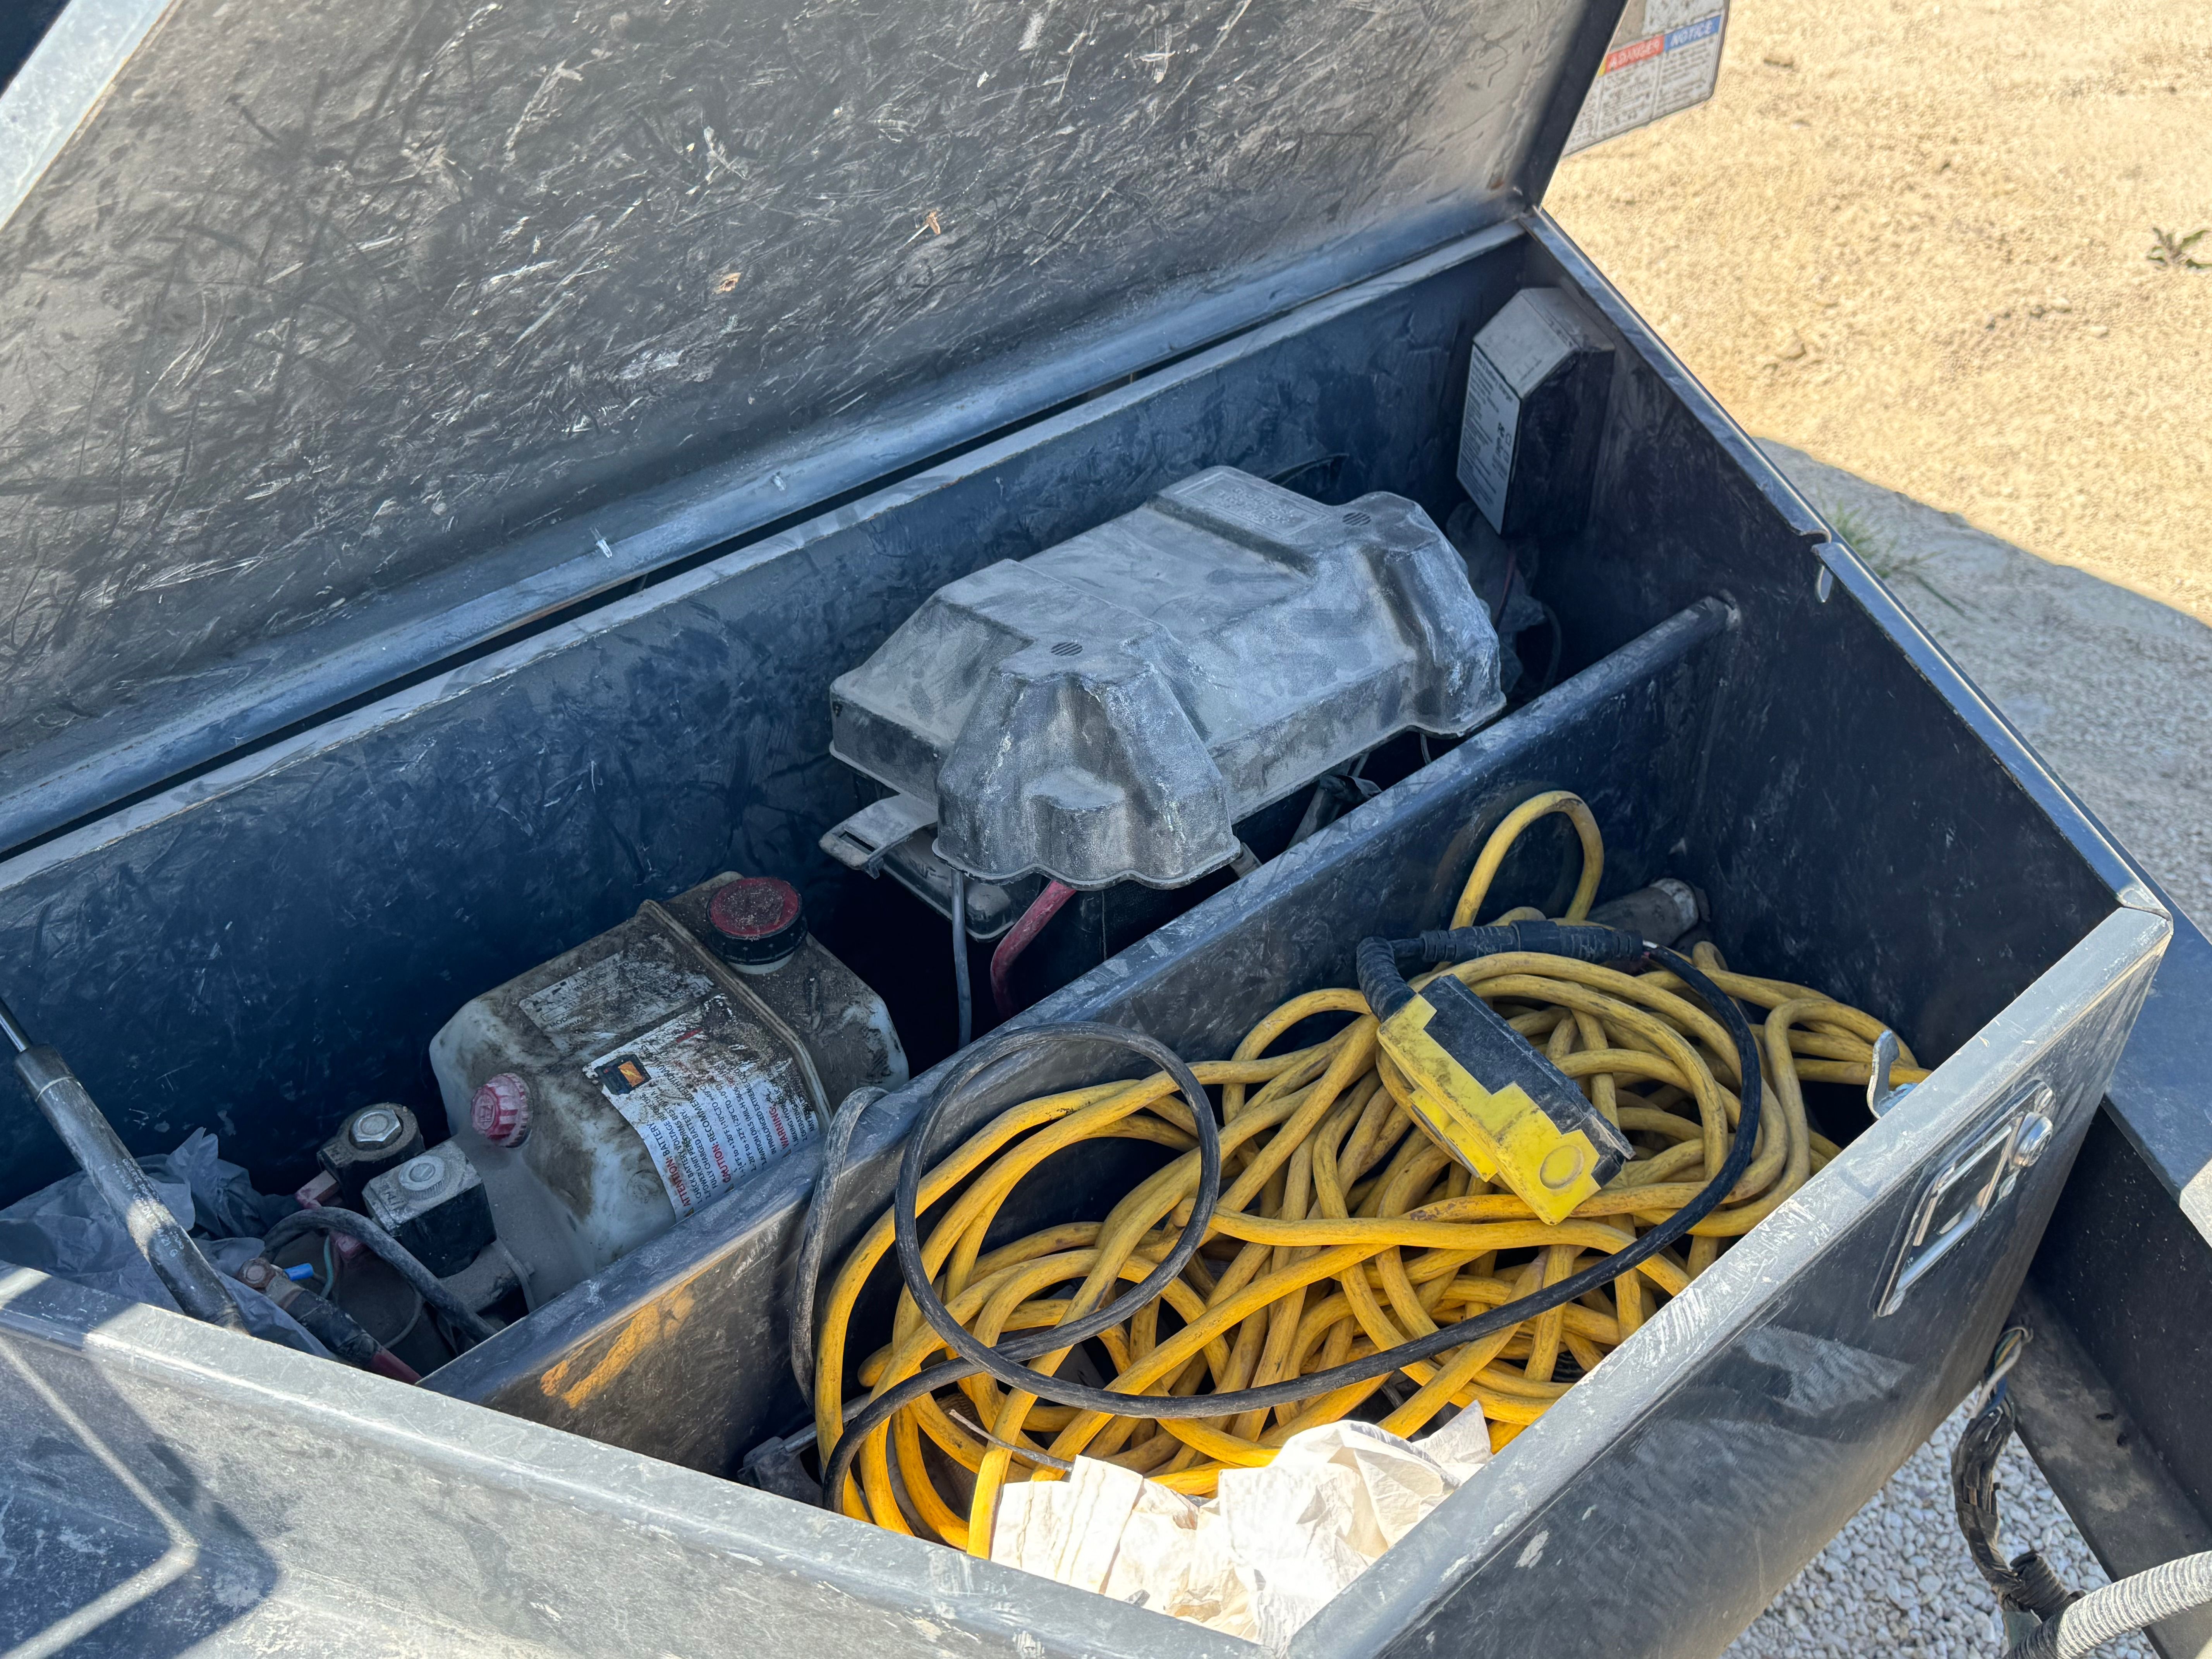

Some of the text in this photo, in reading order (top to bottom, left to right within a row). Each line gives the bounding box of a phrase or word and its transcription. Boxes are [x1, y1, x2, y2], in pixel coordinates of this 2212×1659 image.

[1669, 20, 1713, 46] NOTICE
[1616, 39, 1661, 65] DANGER
[572, 961, 630, 992] INCOPOATED
[658, 969, 679, 982] COD
[563, 1000, 577, 1010] KTI
[548, 1013, 575, 1028] MOD
[731, 1085, 744, 1103] 5606
[743, 1082, 761, 1111] EXTREME
[647, 1102, 667, 1122] BEFORE
[664, 1106, 678, 1121] BEST
[677, 1085, 716, 1143] RECOMMENDED
[738, 1101, 752, 1121] (MIL-H
[663, 1120, 681, 1151] VOLTAGE
[736, 1127, 747, 1143] +32°F
[746, 1120, 757, 1135] OILS
[755, 1111, 775, 1148] PROLONGED
[768, 1105, 790, 1149] WARNING:
[807, 1120, 816, 1132] MAY
[674, 1120, 696, 1156] PERFORMS
[723, 1130, 736, 1148] +120°F
[744, 1144, 750, 1152] to
[678, 1109, 718, 1189] FULLY CHARGED BATTERY.
[733, 1149, 739, 1157] to
[770, 1147, 777, 1155] IN
[646, 1122, 691, 1206] ATTENTION: BATTERY
[677, 1151, 694, 1178] BATTERY
[690, 1156, 701, 1171] UNIT
[711, 1140, 731, 1183] CAUTION:
[689, 1177, 702, 1198] CHECK
